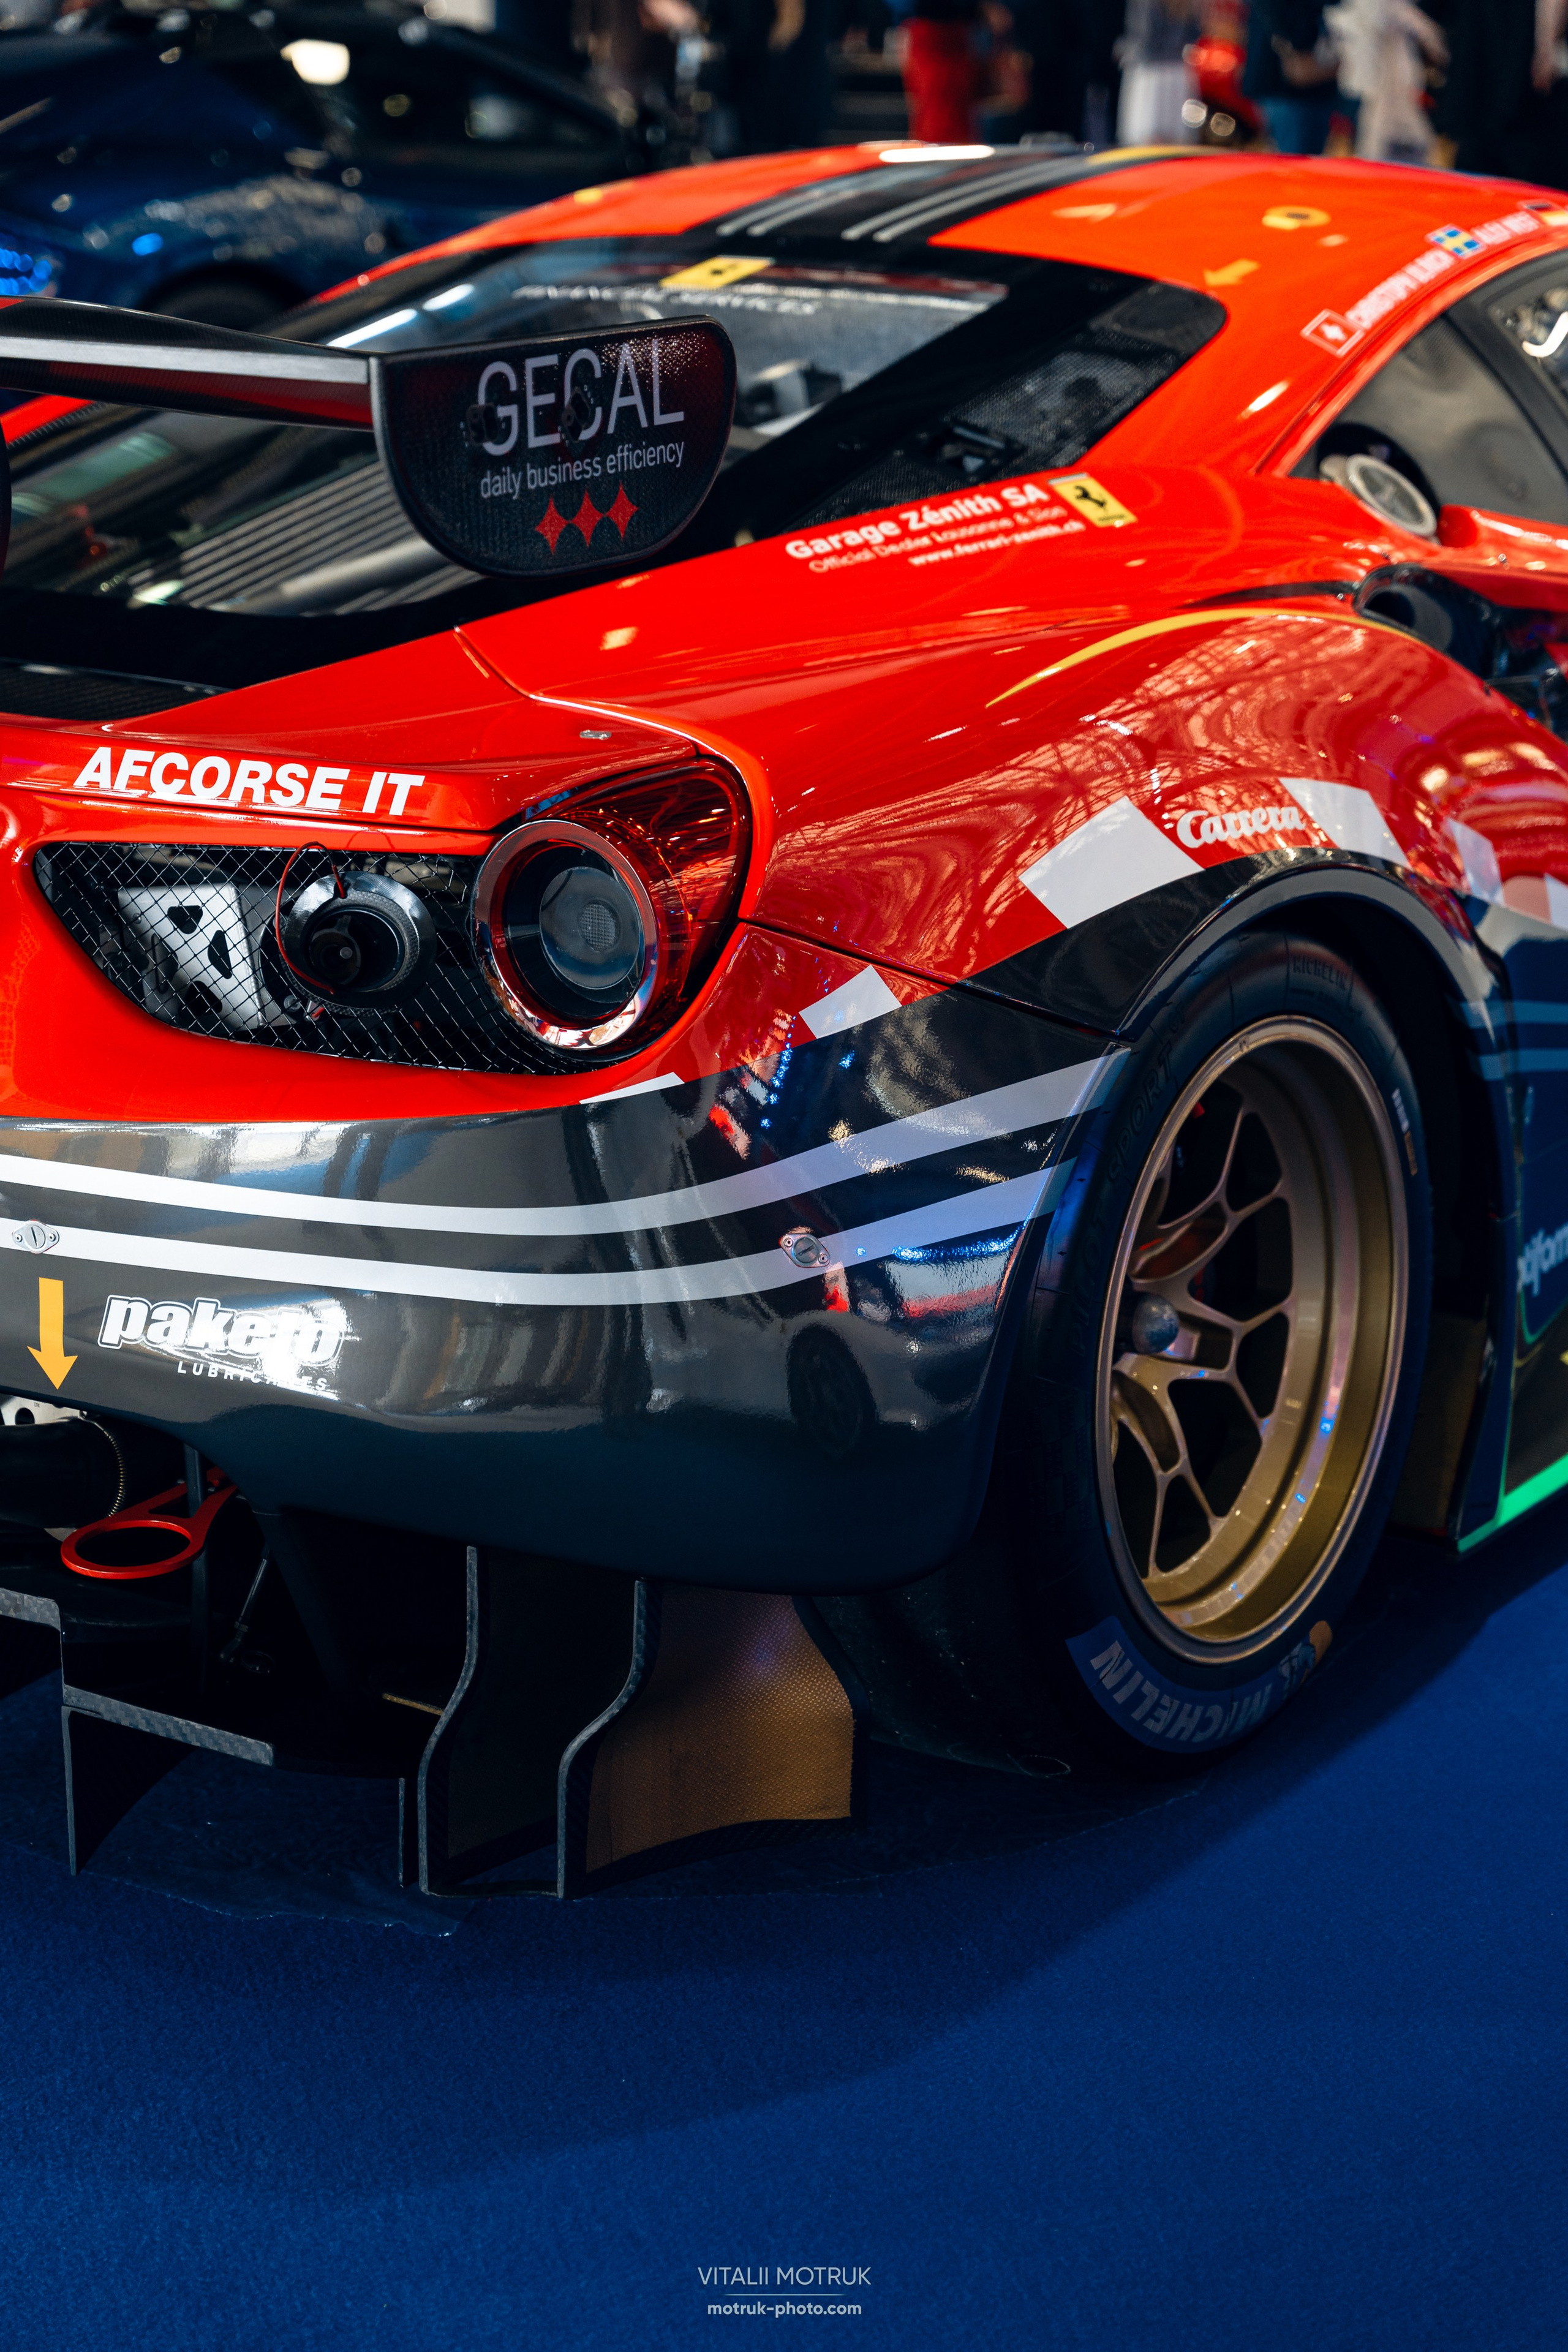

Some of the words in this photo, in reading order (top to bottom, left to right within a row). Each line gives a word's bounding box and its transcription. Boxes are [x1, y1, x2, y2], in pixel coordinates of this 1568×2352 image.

[478, 339, 684, 456] GECAL
[480, 466, 522, 500] daily
[527, 456, 601, 489] business
[606, 442, 684, 475] efficiency
[785, 521, 902, 559] Garage
[899, 494, 1003, 531] Zénith
[1001, 483, 1050, 508] SA
[72, 746, 350, 810] AFCORSE
[361, 771, 426, 816] IT
[1177, 806, 1306, 849] Carrera
[98, 1295, 344, 1367] pakelo
[1090, 1640, 1272, 1743] MICHELIN
